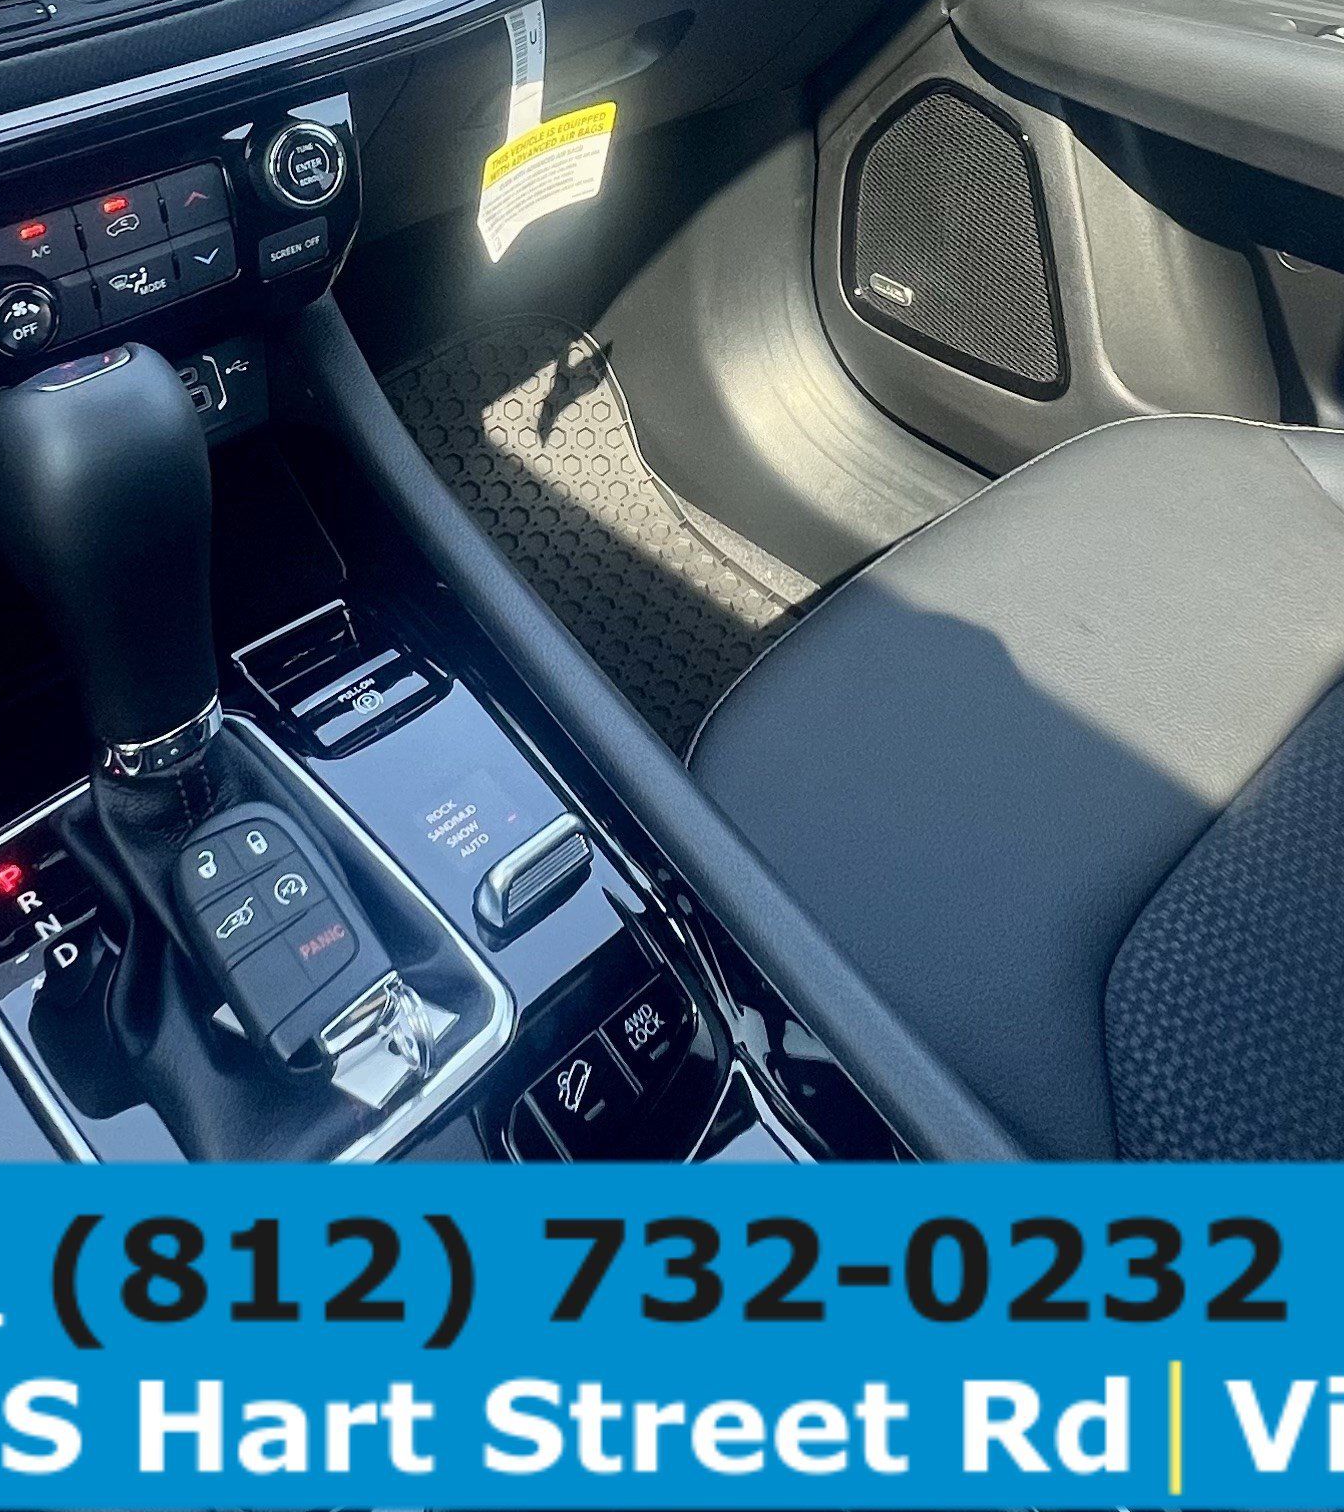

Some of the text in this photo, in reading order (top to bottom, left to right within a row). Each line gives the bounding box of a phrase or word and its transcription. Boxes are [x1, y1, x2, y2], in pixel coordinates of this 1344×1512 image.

[490, 123, 604, 182] WITH ADVANCED AIR BAGS
[492, 112, 606, 170] THIS VEHICLE IS EQUIPPED
[295, 157, 323, 173] ENTER
[30, 244, 52, 260] A/C
[270, 236, 320, 262] SCREEN OFF
[139, 277, 167, 296] MODE
[12, 323, 39, 341] OFF
[337, 677, 376, 703] PULL ON
[425, 799, 457, 824] ROCK
[446, 819, 479, 848] SNOW
[460, 833, 490, 858] AUTO
[17, 890, 44, 914] R
[35, 914, 62, 941] N
[299, 923, 346, 961] PANIC
[53, 942, 79, 969] D
[623, 1003, 654, 1035] 4WD
[628, 1011, 665, 1051] LOCK
